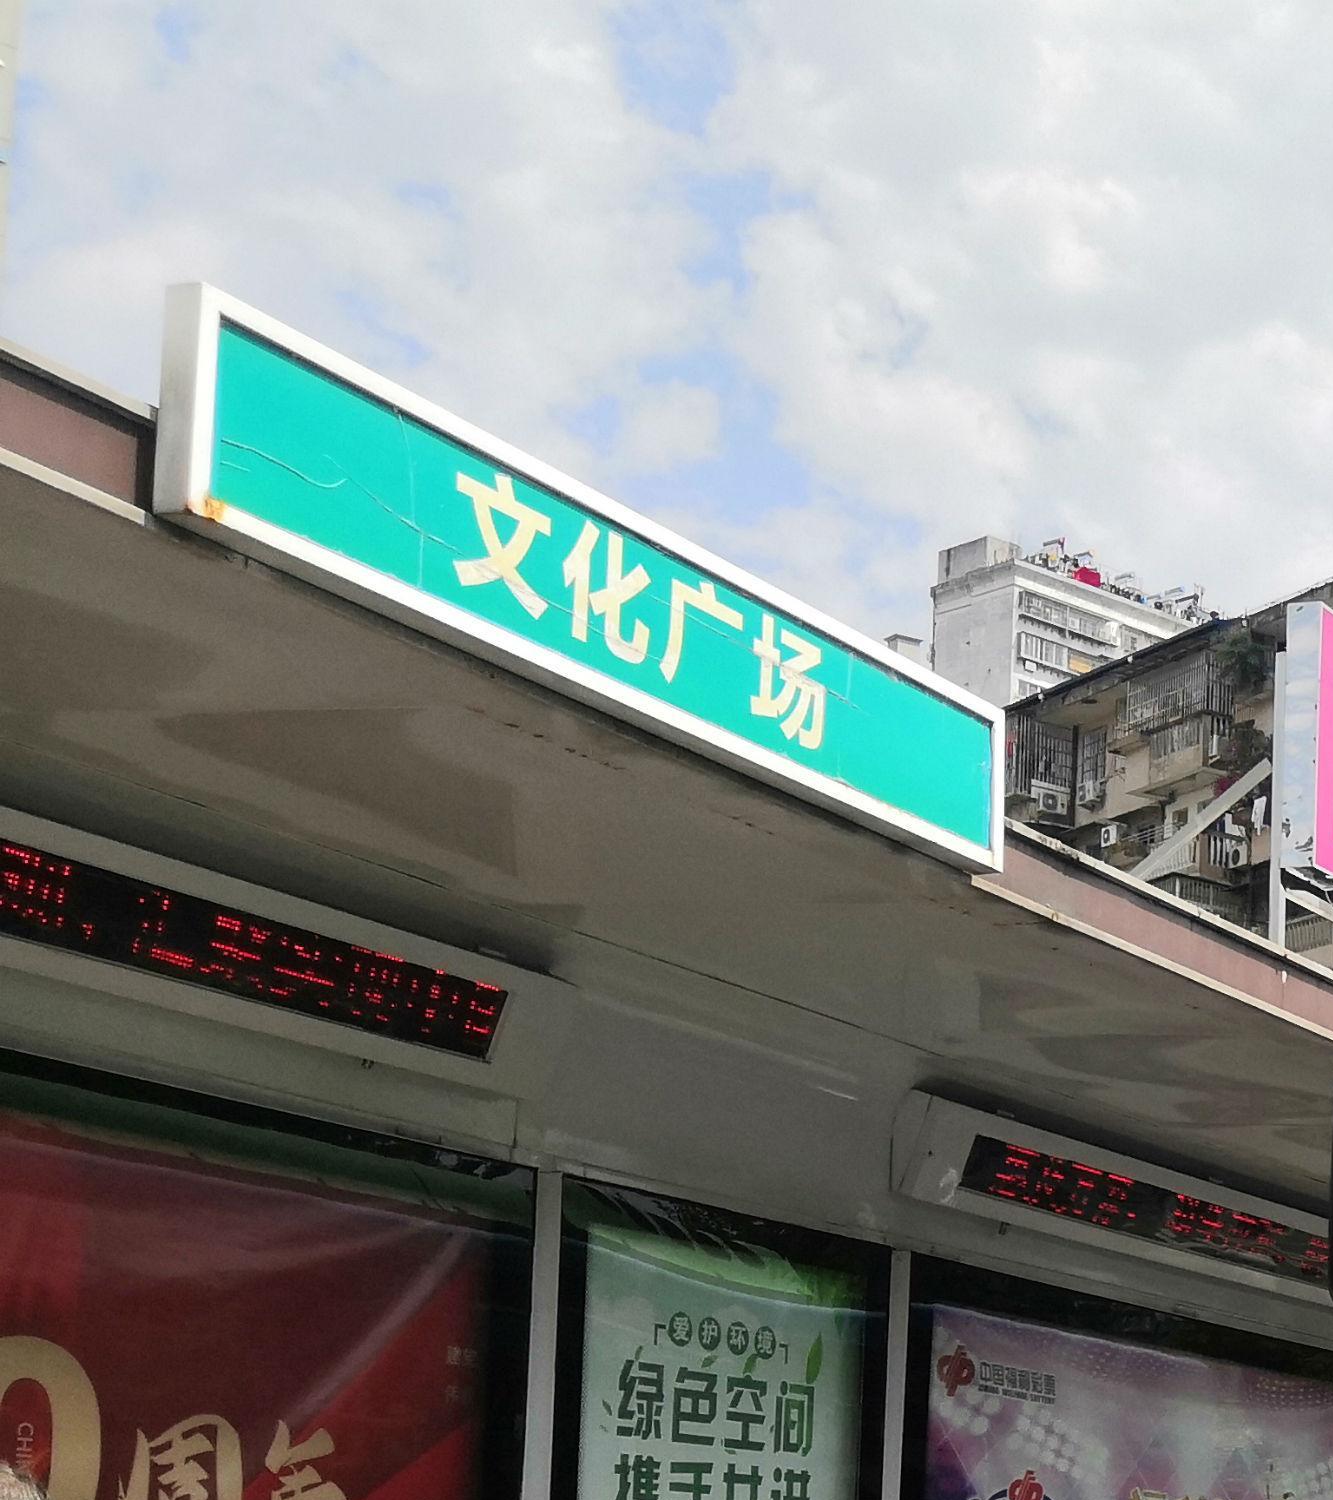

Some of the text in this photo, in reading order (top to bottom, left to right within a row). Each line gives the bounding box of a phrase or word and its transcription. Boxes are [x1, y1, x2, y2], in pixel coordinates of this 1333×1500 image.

[453, 473, 827, 750] 文化广场
[667, 1312, 776, 1359] 爱护环境
[616, 1359, 815, 1457] 绿色空间
